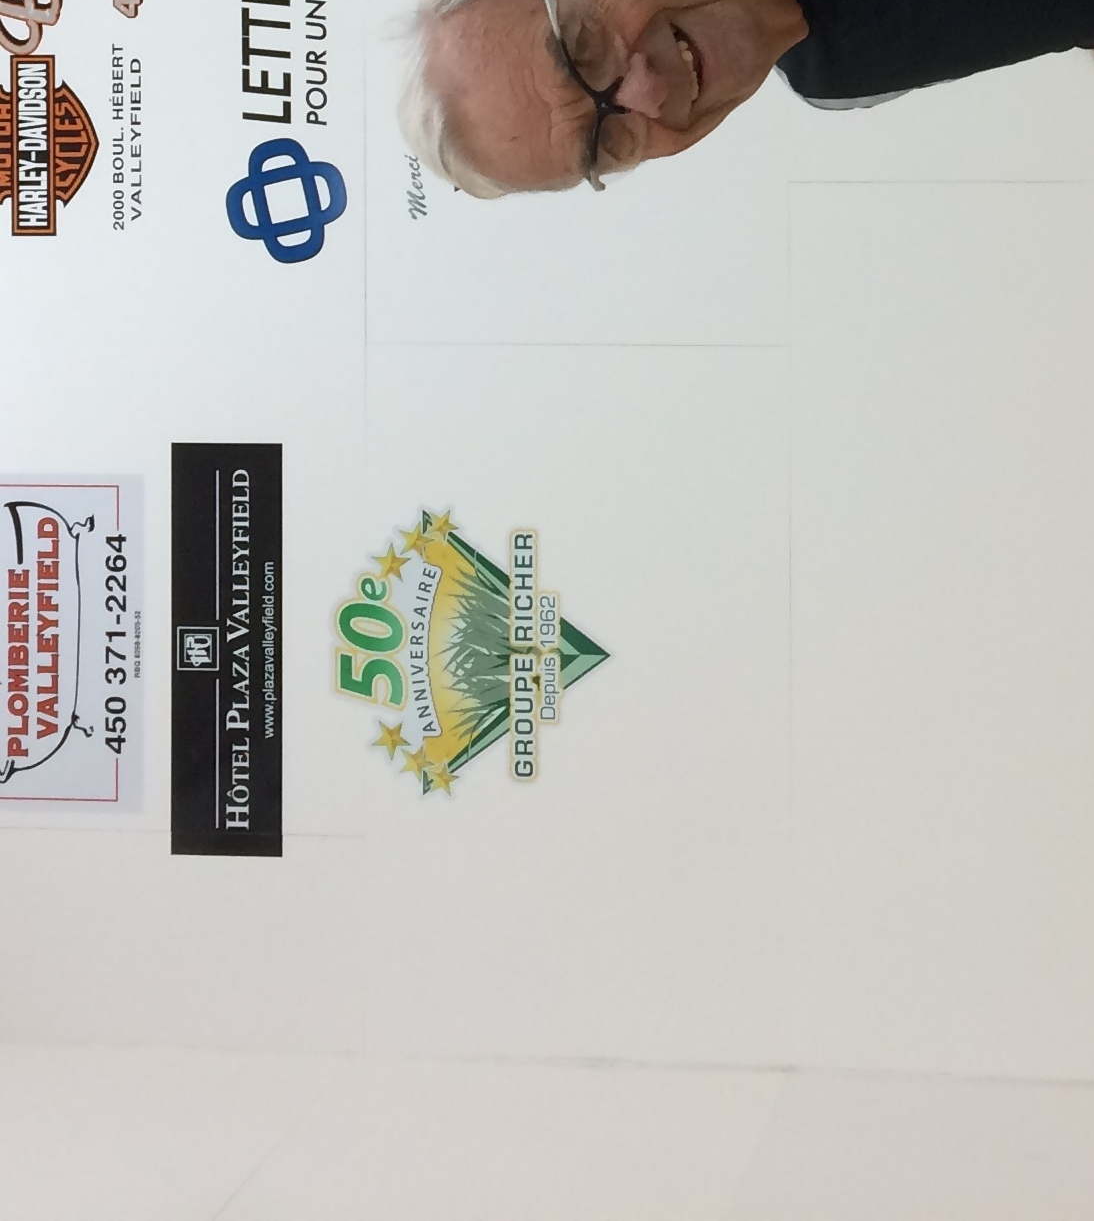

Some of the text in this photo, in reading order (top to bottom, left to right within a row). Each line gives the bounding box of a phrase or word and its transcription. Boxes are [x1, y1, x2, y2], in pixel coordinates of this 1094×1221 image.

[17, 63, 48, 227] HARLEY-DAVIDSON
[55, 102, 89, 187] CYCLES
[108, 43, 125, 231] 2000 BOUL. HÉBERT
[130, 57, 142, 221] VALLEYFIELD
[304, 49, 327, 126] POUR
[7, 568, 29, 758] PLOMBERIE
[36, 516, 60, 740] VALLEYFIELD
[105, 533, 127, 754] 450 371-2264
[262, 561, 277, 739] www.plazavalleyfield.com
[409, 566, 438, 733] ANNIVERSAIRE
[513, 532, 534, 778] GROUPE RICHER
[539, 595, 560, 720] Depuis 1962
